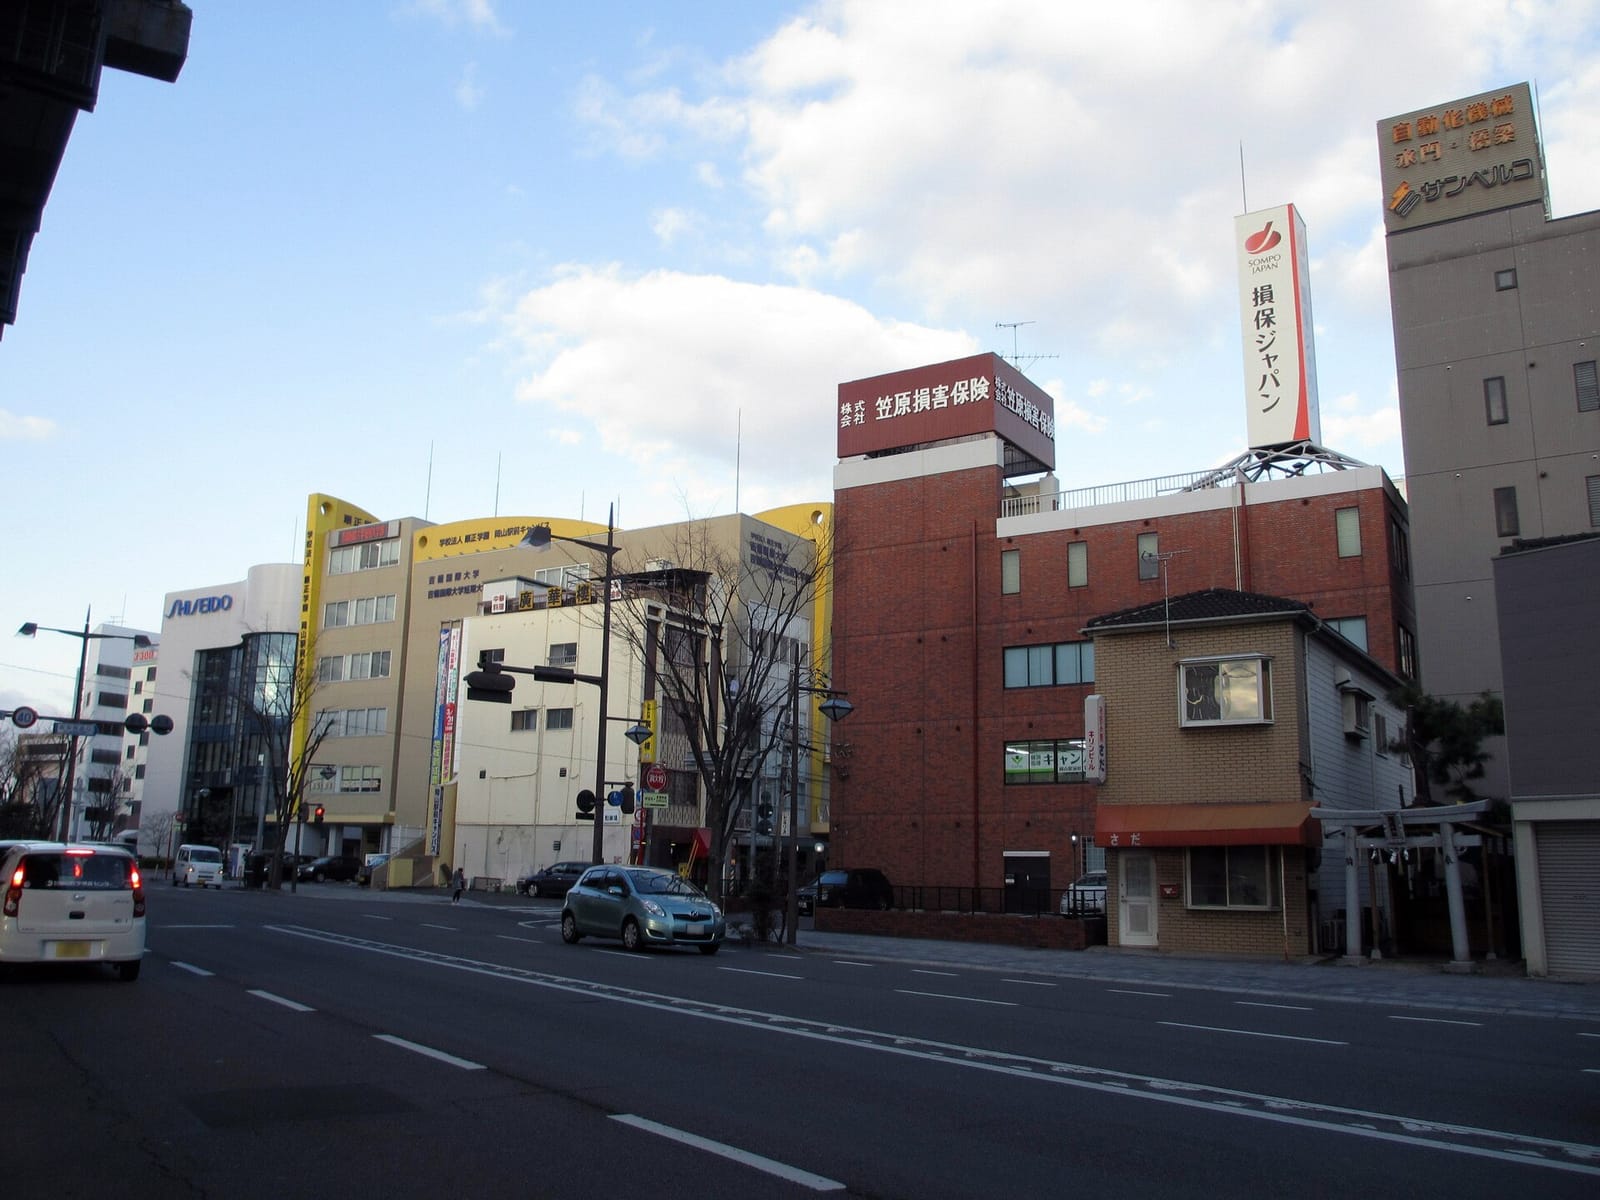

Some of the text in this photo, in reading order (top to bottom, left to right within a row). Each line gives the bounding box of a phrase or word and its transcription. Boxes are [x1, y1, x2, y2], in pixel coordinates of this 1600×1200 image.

[1393, 94, 1514, 143] 自動化機械
[1421, 158, 1534, 202] サンベルコ
[1248, 254, 1281, 268] SOMPO
[1252, 262, 1279, 275] JAPAN
[1252, 283, 1281, 414] 損保ジャパン
[875, 375, 991, 421] 笠原損害保険
[840, 399, 866, 415] 株式
[840, 412, 866, 428] 会社
[165, 595, 232, 619] SHISEIDO
[18, 712, 32, 723] 40
[1110, 832, 1142, 846] さだ
